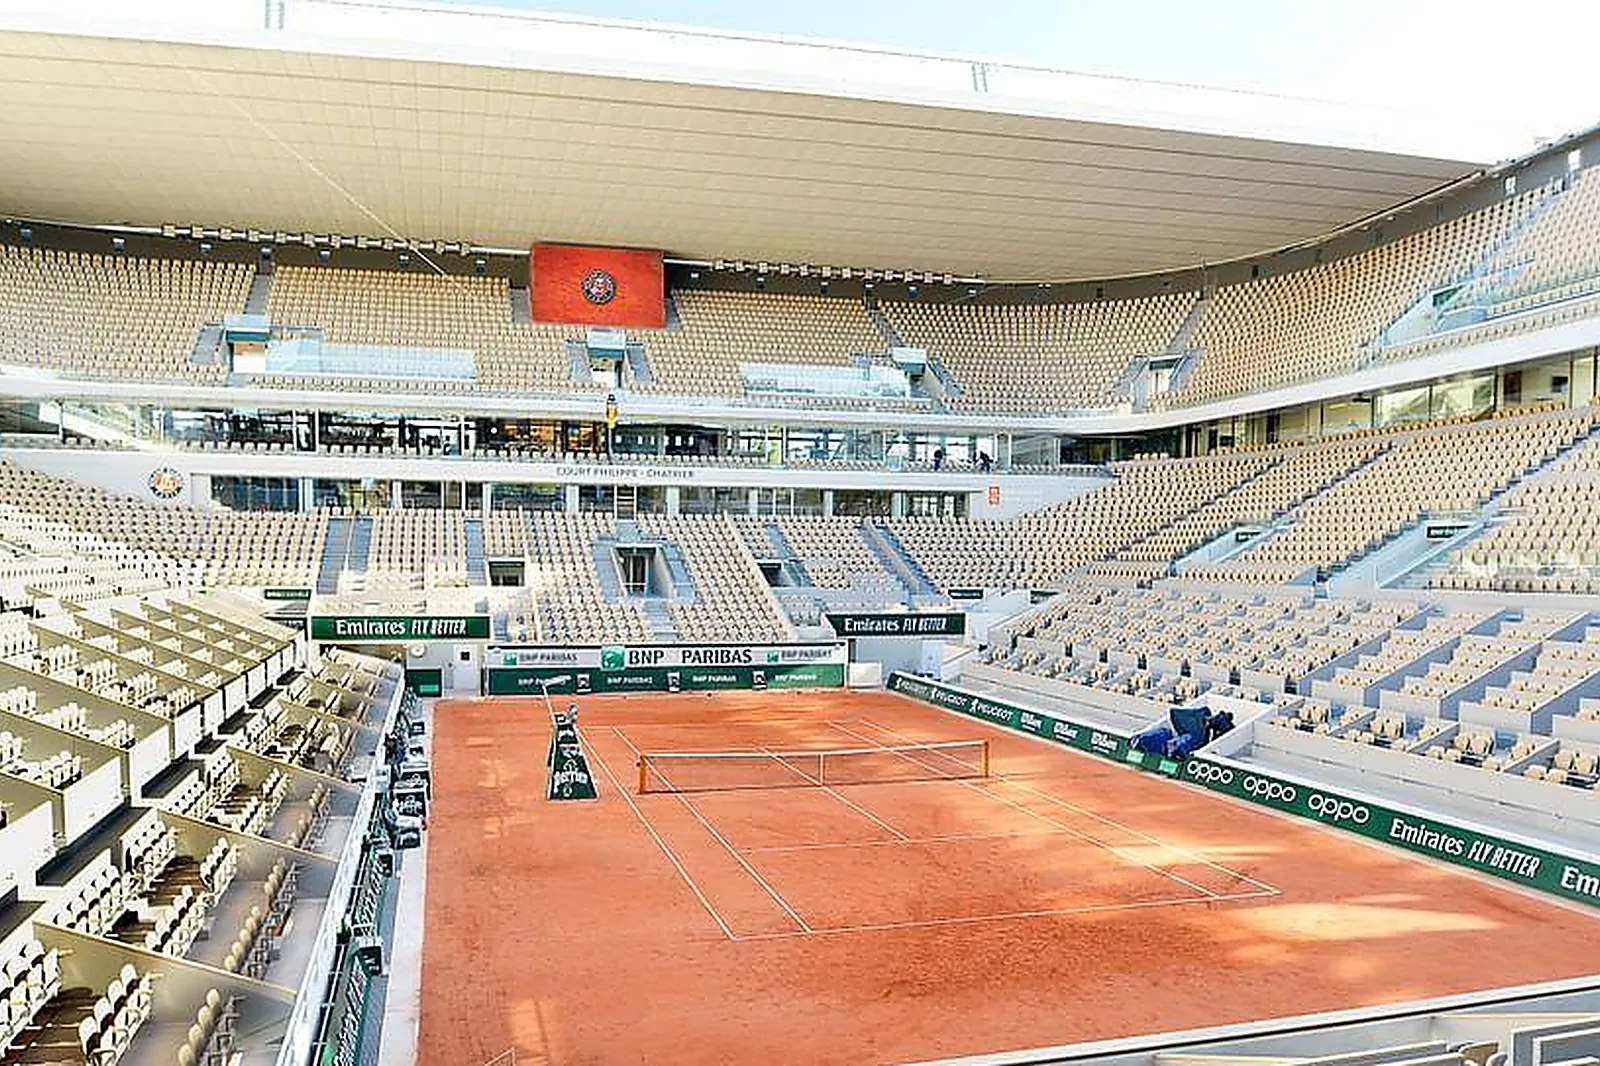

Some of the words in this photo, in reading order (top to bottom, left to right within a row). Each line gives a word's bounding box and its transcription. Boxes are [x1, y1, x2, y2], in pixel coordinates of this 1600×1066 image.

[556, 467, 590, 477] COURT
[594, 467, 637, 478] PHILIPPE
[646, 468, 694, 479] CHATRIER
[335, 619, 406, 635] Emirates
[431, 619, 467, 635] BETTER
[844, 617, 899, 632] Emirates
[918, 617, 948, 632] BETTER
[628, 649, 664, 665] BNP
[682, 648, 752, 664] PARIBAS
[976, 702, 1014, 721] PEUGEOT
[1187, 760, 1234, 784] oppo
[1243, 776, 1297, 802] oppo
[1308, 794, 1370, 825] oppo
[1389, 818, 1466, 856] Emirates
[1467, 840, 1494, 864] FLY
[1491, 848, 1541, 878] BETTER
[1561, 865, 1600, 897] Em
